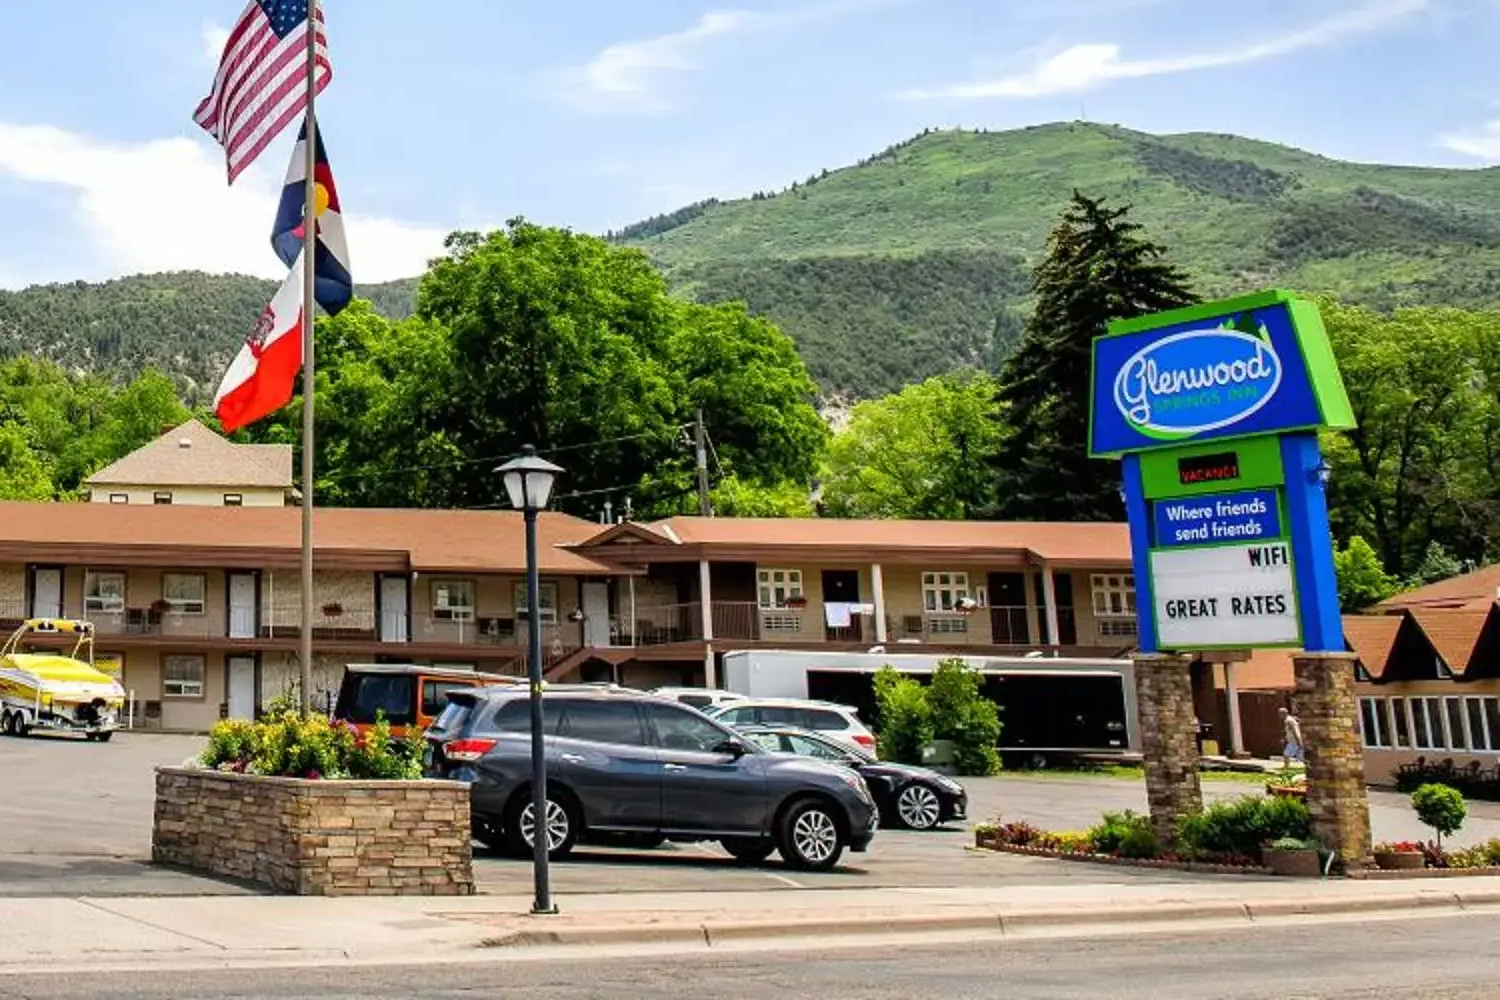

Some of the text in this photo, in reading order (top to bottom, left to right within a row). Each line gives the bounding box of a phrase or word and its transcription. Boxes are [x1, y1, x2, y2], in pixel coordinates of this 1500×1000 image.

[1122, 337, 1271, 424] Glenwood
[1166, 498, 1267, 521] Where friends
[1175, 519, 1262, 540] send friends
[1248, 547, 1288, 567] WIFI
[1165, 595, 1286, 619] GREAT RATES
